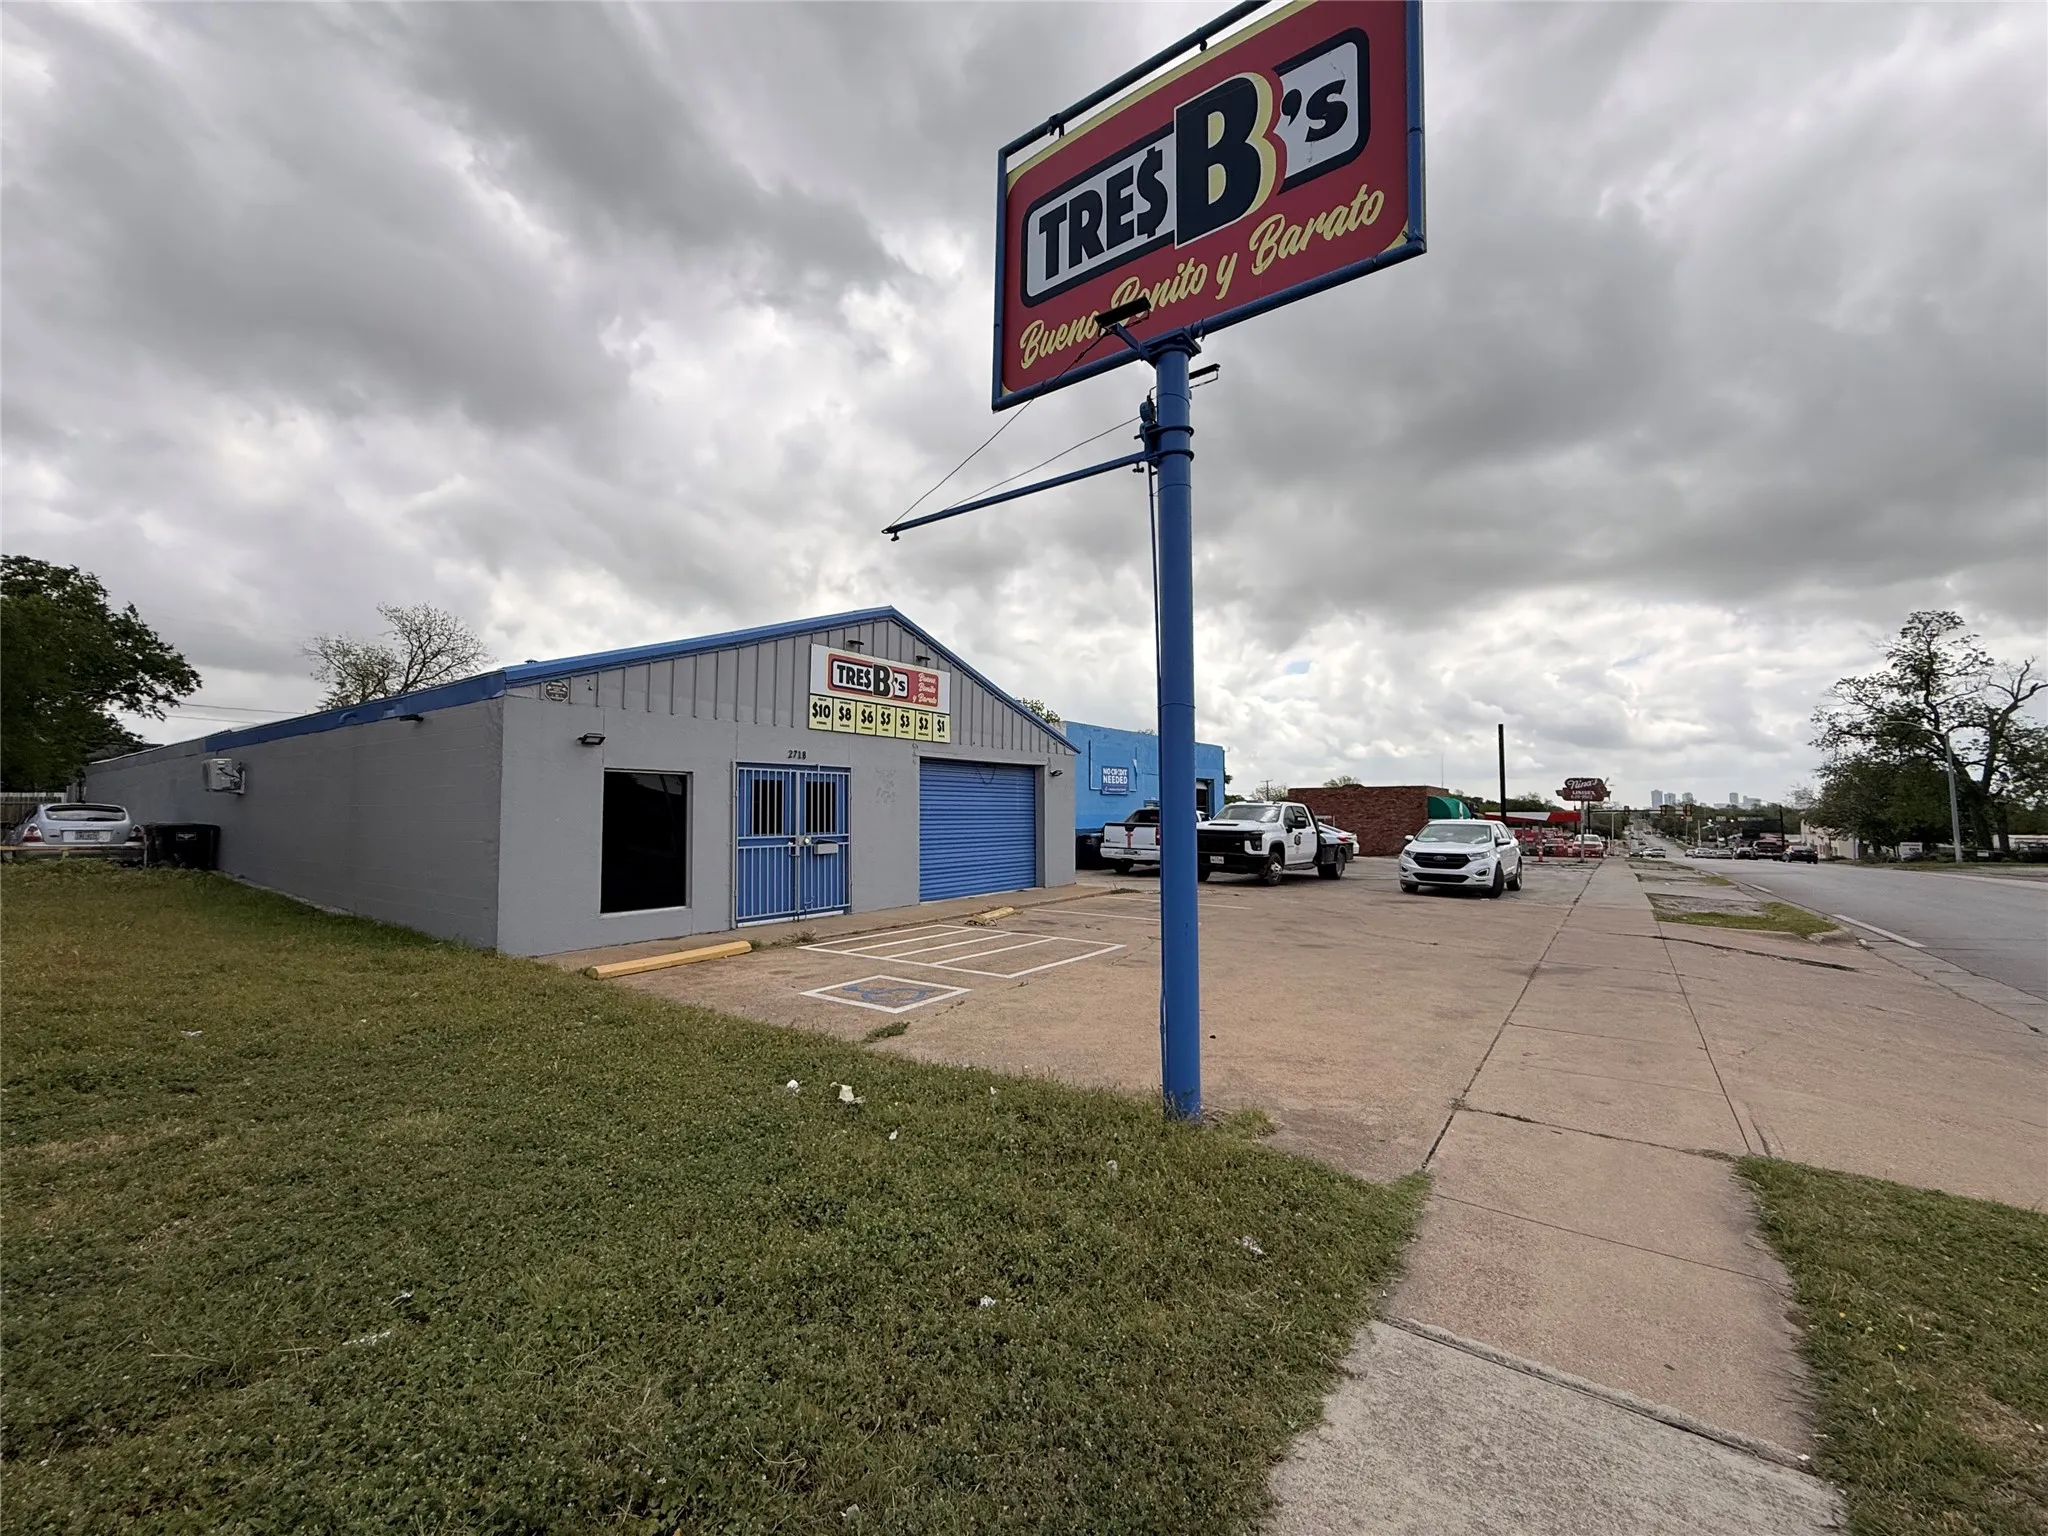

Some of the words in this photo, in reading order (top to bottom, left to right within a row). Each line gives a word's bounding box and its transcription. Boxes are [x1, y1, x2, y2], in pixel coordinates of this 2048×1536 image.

[1215, 252, 1238, 300] y
[1248, 183, 1386, 276] Barato
[812, 702, 831, 719] $10
[838, 705, 852, 722] $8
[861, 708, 874, 725] $6
[880, 710, 892, 726] $5
[900, 713, 910, 729] $3
[918, 716, 929, 731] $2
[937, 719, 945, 733] $1
[788, 750, 807, 760] 2718
[1102, 775, 1128, 784] NEEDED
